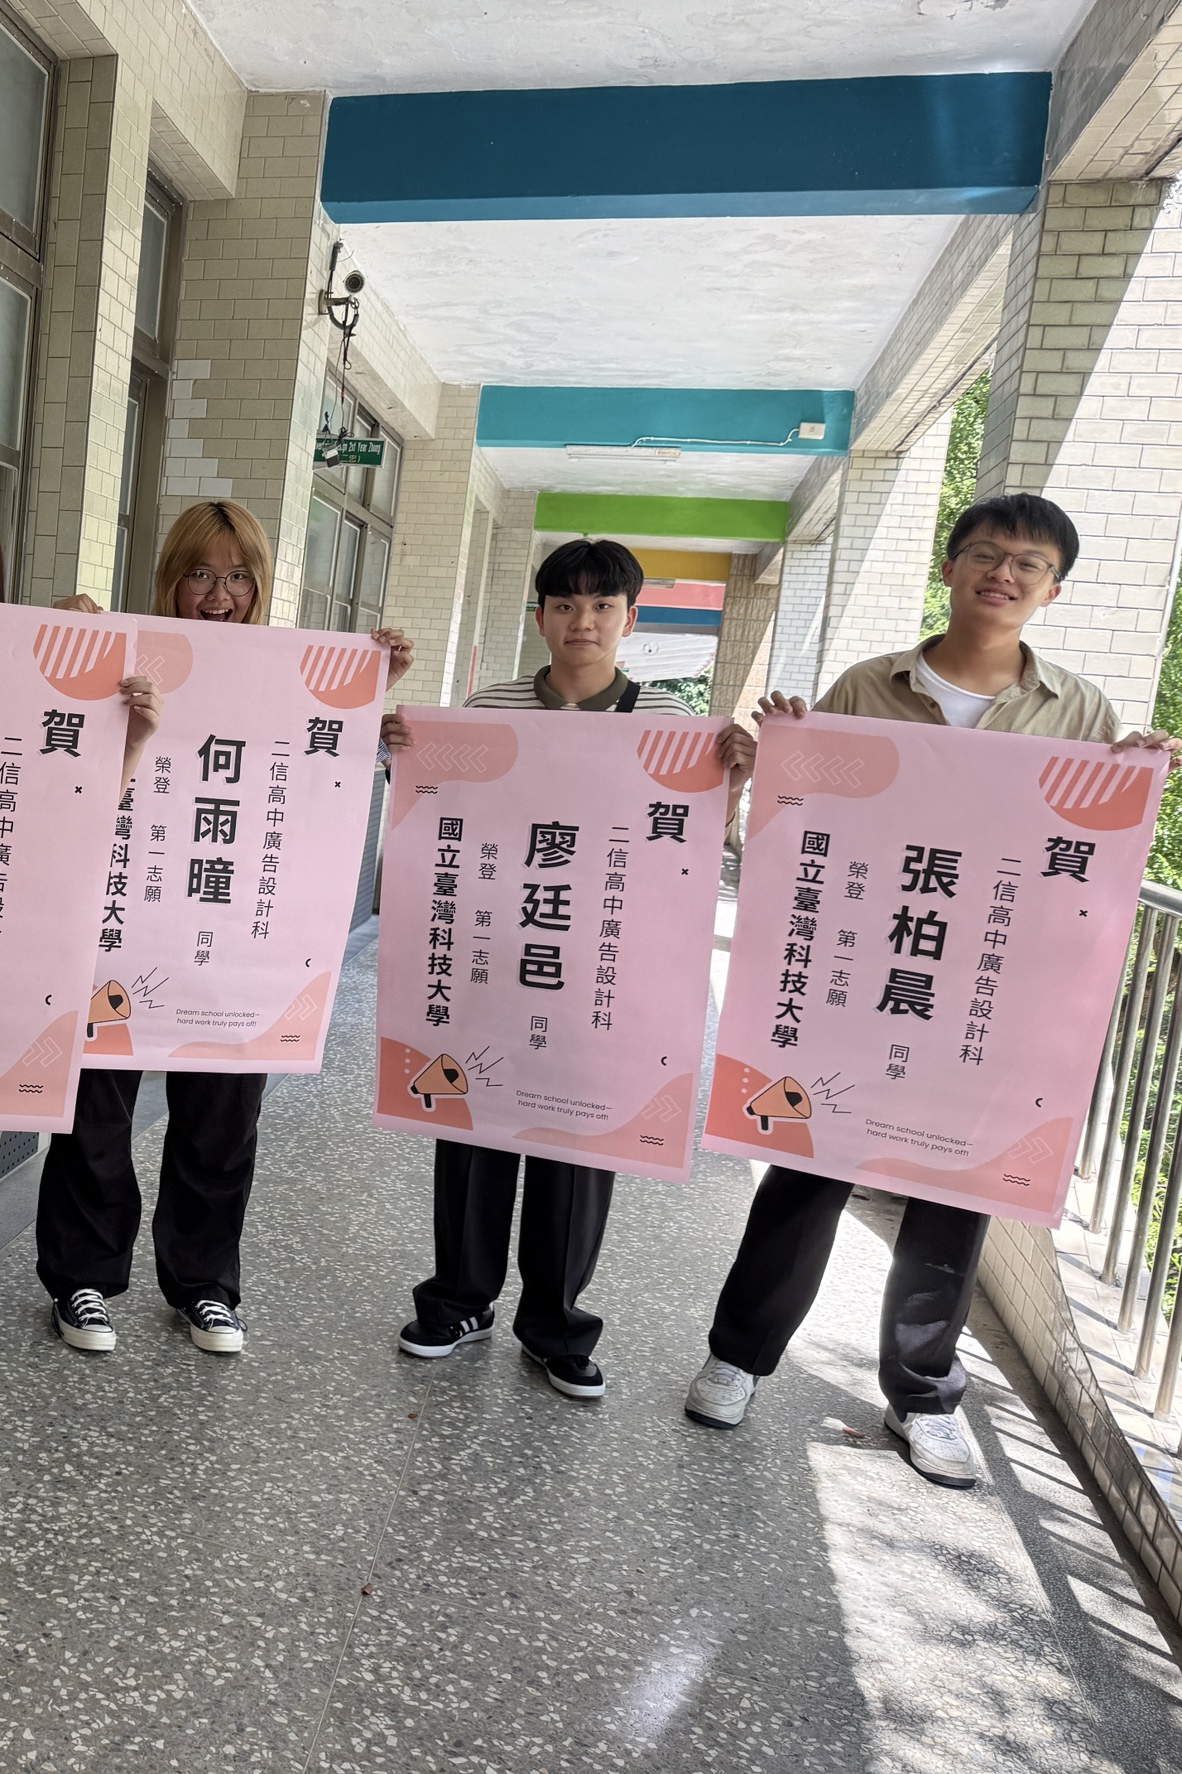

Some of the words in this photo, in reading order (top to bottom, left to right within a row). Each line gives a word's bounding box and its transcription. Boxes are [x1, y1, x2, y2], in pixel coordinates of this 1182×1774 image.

[39, 709, 85, 758] 賀
[304, 716, 344, 758] 賀
[153, 758, 171, 794] 榮登
[251, 741, 290, 939] 二信高中廣告設計科
[645, 801, 690, 844] 賀
[98, 778, 136, 953] 臺灣科技大學
[143, 824, 167, 903] 第一志願
[478, 842, 498, 880] 榮登
[844, 861, 868, 901] 榮登
[1040, 836, 1096, 883] 賀
[425, 816, 464, 1027] 國立臺灣科技大學
[518, 820, 580, 991] 廖廷邑
[194, 931, 214, 966] 同學
[470, 909, 493, 985] 第一志願
[591, 826, 630, 1031] 二信高中廣告設計科
[770, 830, 832, 1049] 國立臺灣科技大學
[875, 844, 963, 1021] 張柏晨
[824, 929, 858, 1007] 第一志願
[956, 857, 1022, 1066] 二信高中廣告設計科
[176, 1008, 199, 1016] Dream
[529, 1015, 548, 1050] 同學
[886, 1044, 910, 1080] 同學
[516, 1090, 542, 1099] Dream
[543, 1095, 568, 1104] school
[518, 1100, 536, 1108] hard
[557, 1106, 574, 1116] truly
[575, 1110, 594, 1118] pays
[865, 1119, 895, 1130] Dream
[896, 1126, 925, 1137] school
[867, 1129, 887, 1138] hard
[889, 1134, 909, 1143] work
[911, 1139, 930, 1149] truly
[931, 1143, 953, 1153] pays
